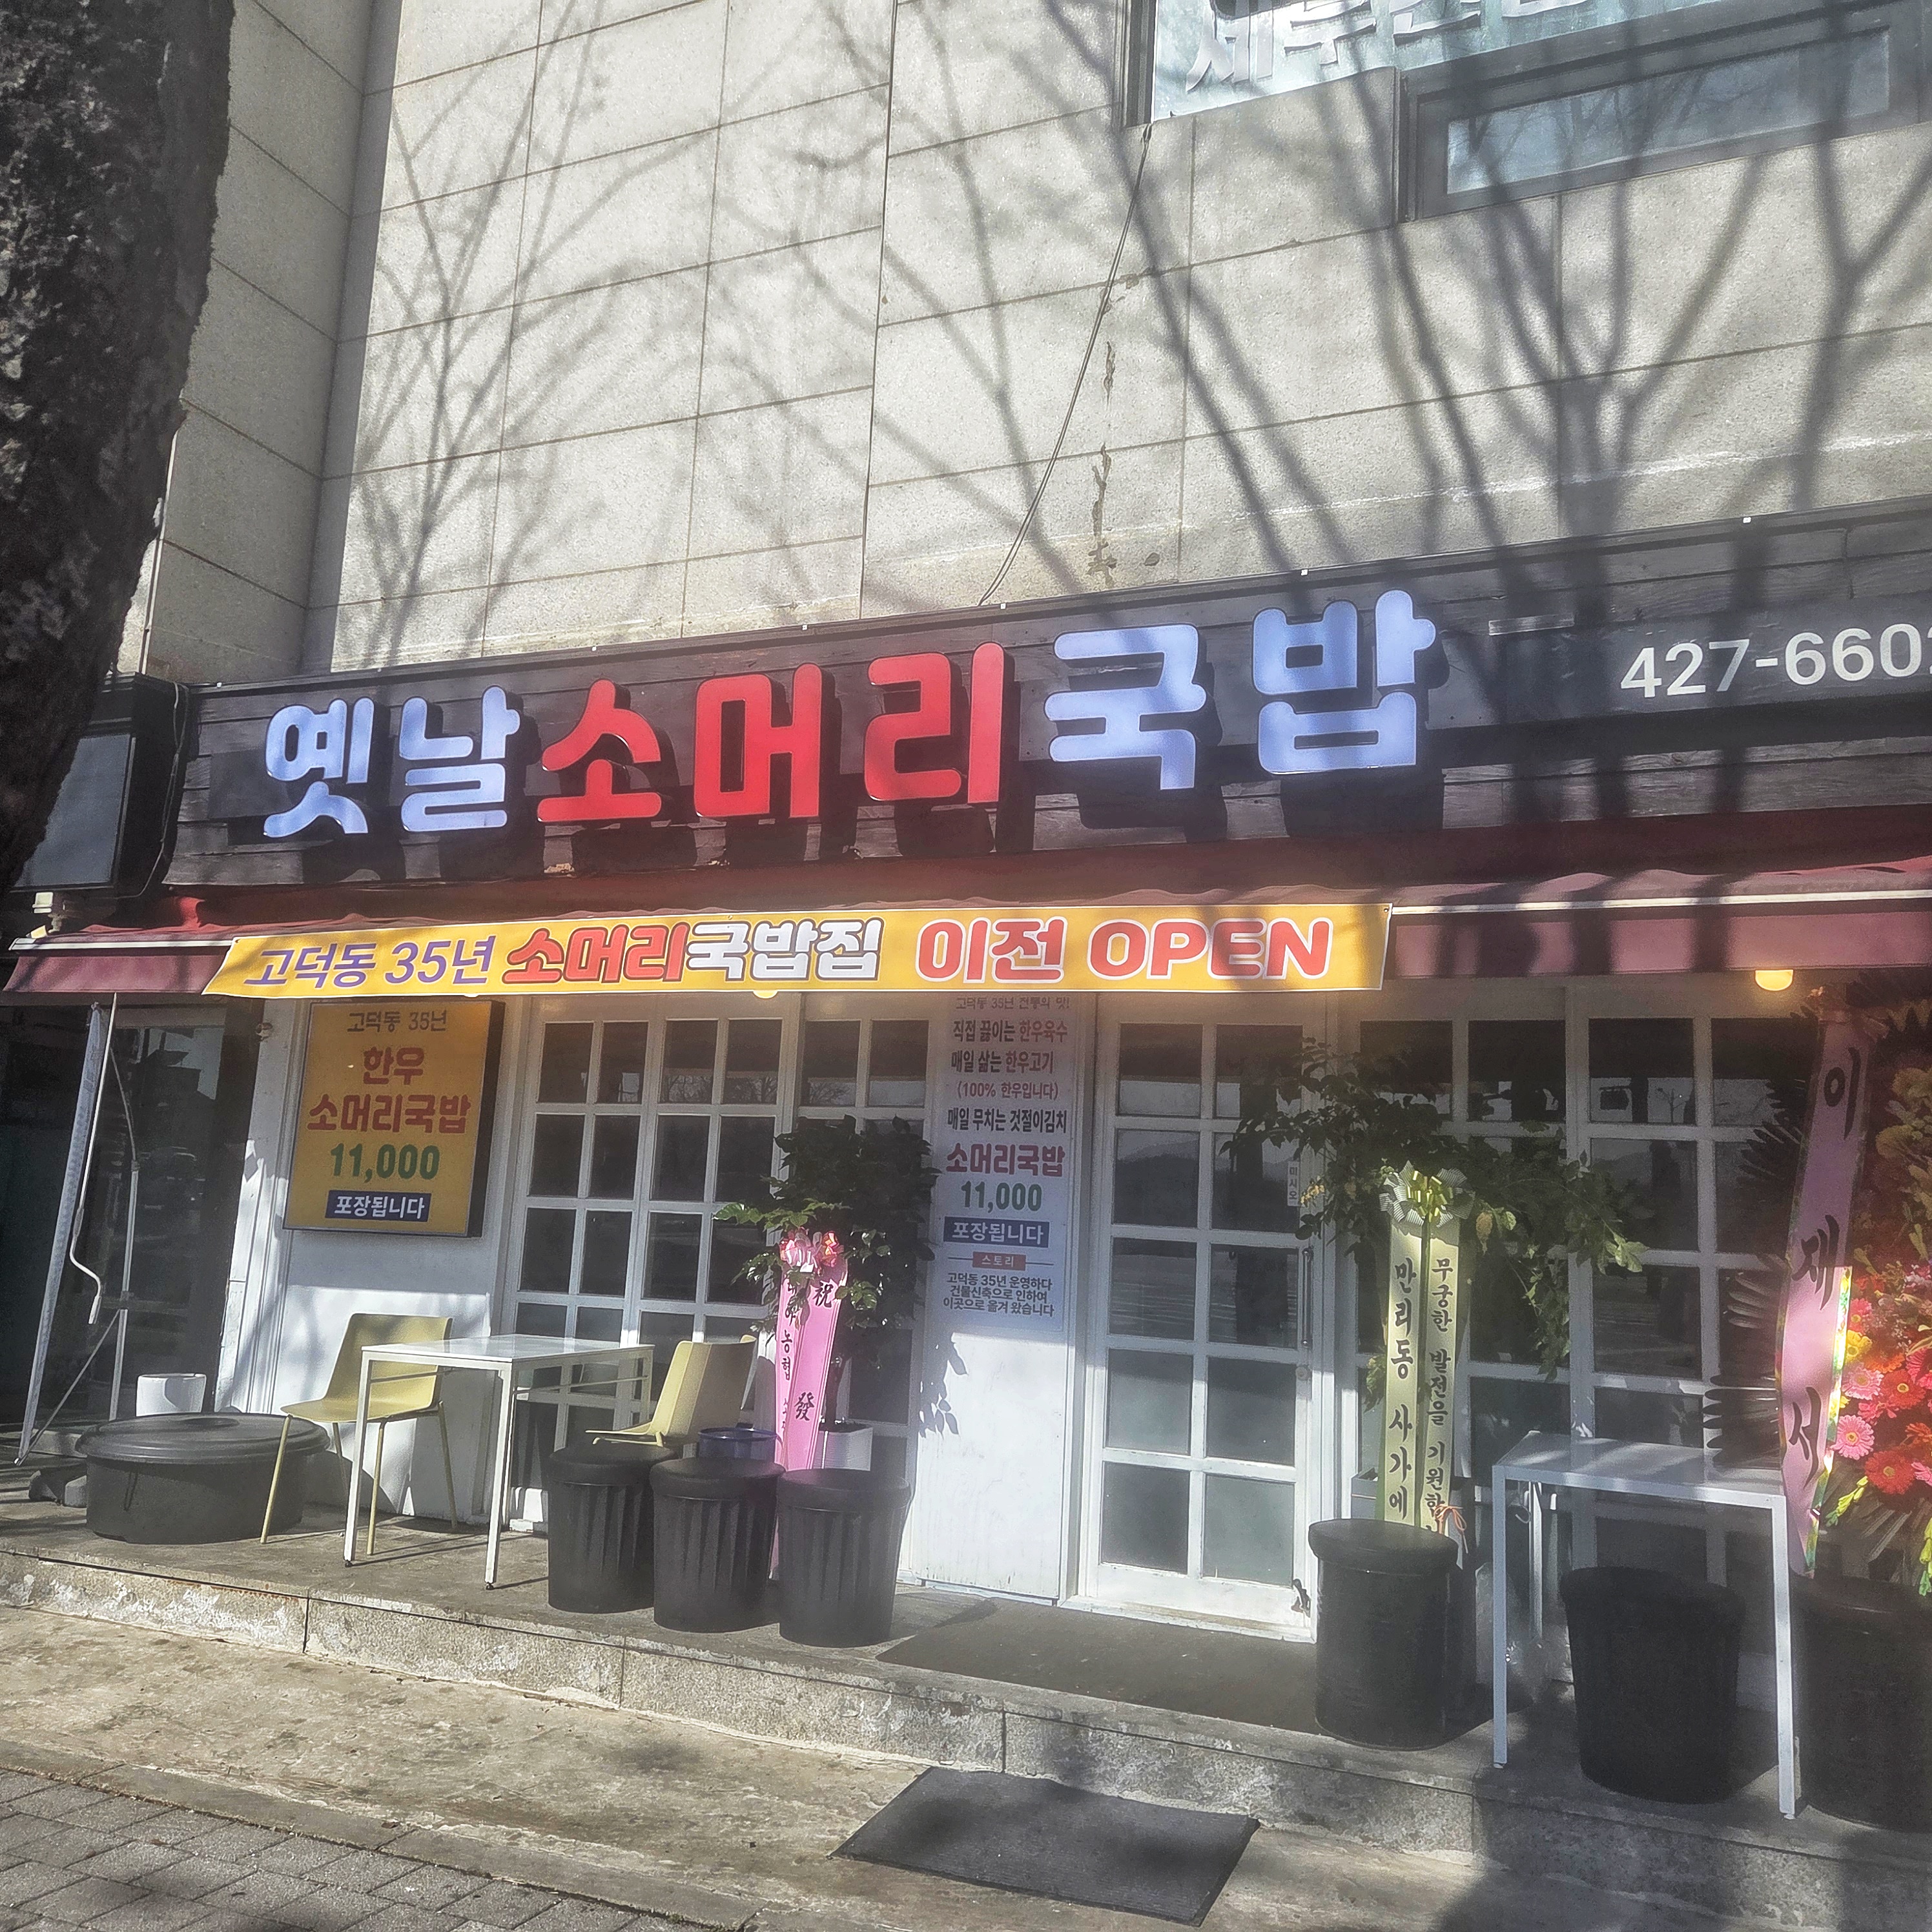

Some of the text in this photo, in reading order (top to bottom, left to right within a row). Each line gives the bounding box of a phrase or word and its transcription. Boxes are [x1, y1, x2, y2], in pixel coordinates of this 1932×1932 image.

[1620, 623, 1932, 697] 427-660
[243, 943, 376, 989] 고덕동
[387, 934, 495, 984] 35년
[915, 916, 1065, 983] 이전
[1087, 918, 1334, 981] OPEN
[956, 997, 987, 1009] 고덕동
[991, 997, 1014, 1009] 35년
[1018, 996, 1051, 1010] 전통의
[347, 1010, 447, 1033] 고덕동 35년
[953, 1020, 1068, 1043] 직접 끓이는 한우육수
[363, 1047, 425, 1085] 한우
[951, 1050, 1054, 1074] 매일 삶는 한우고기
[958, 1081, 1059, 1100] (100% 한우입니다)
[307, 1094, 471, 1133] 소머리국밥
[947, 1107, 969, 1131] 매일
[972, 1107, 1007, 1131] 무치는
[331, 1143, 440, 1183] 11,000
[946, 1142, 1065, 1177] 소머리국밥
[1289, 1166, 1298, 1200] 미시오
[334, 1195, 425, 1219] 포장됩니다
[961, 1181, 1042, 1213] 11,000
[952, 1222, 1044, 1245] 포장됩니다
[981, 1255, 1014, 1268] 스토리
[812, 1280, 834, 1308] 祝
[981, 1275, 1007, 1288] 35년
[1009, 1275, 1053, 1291] 운영하다
[943, 1297, 1055, 1317] 이곳으로 옮겨 왔습니다
[1016, 1290, 1047, 1304] 인하여
[1388, 1257, 1417, 1520] 만리동 사가에
[1424, 1258, 1454, 1532] 무궁한 발전을 기원합
